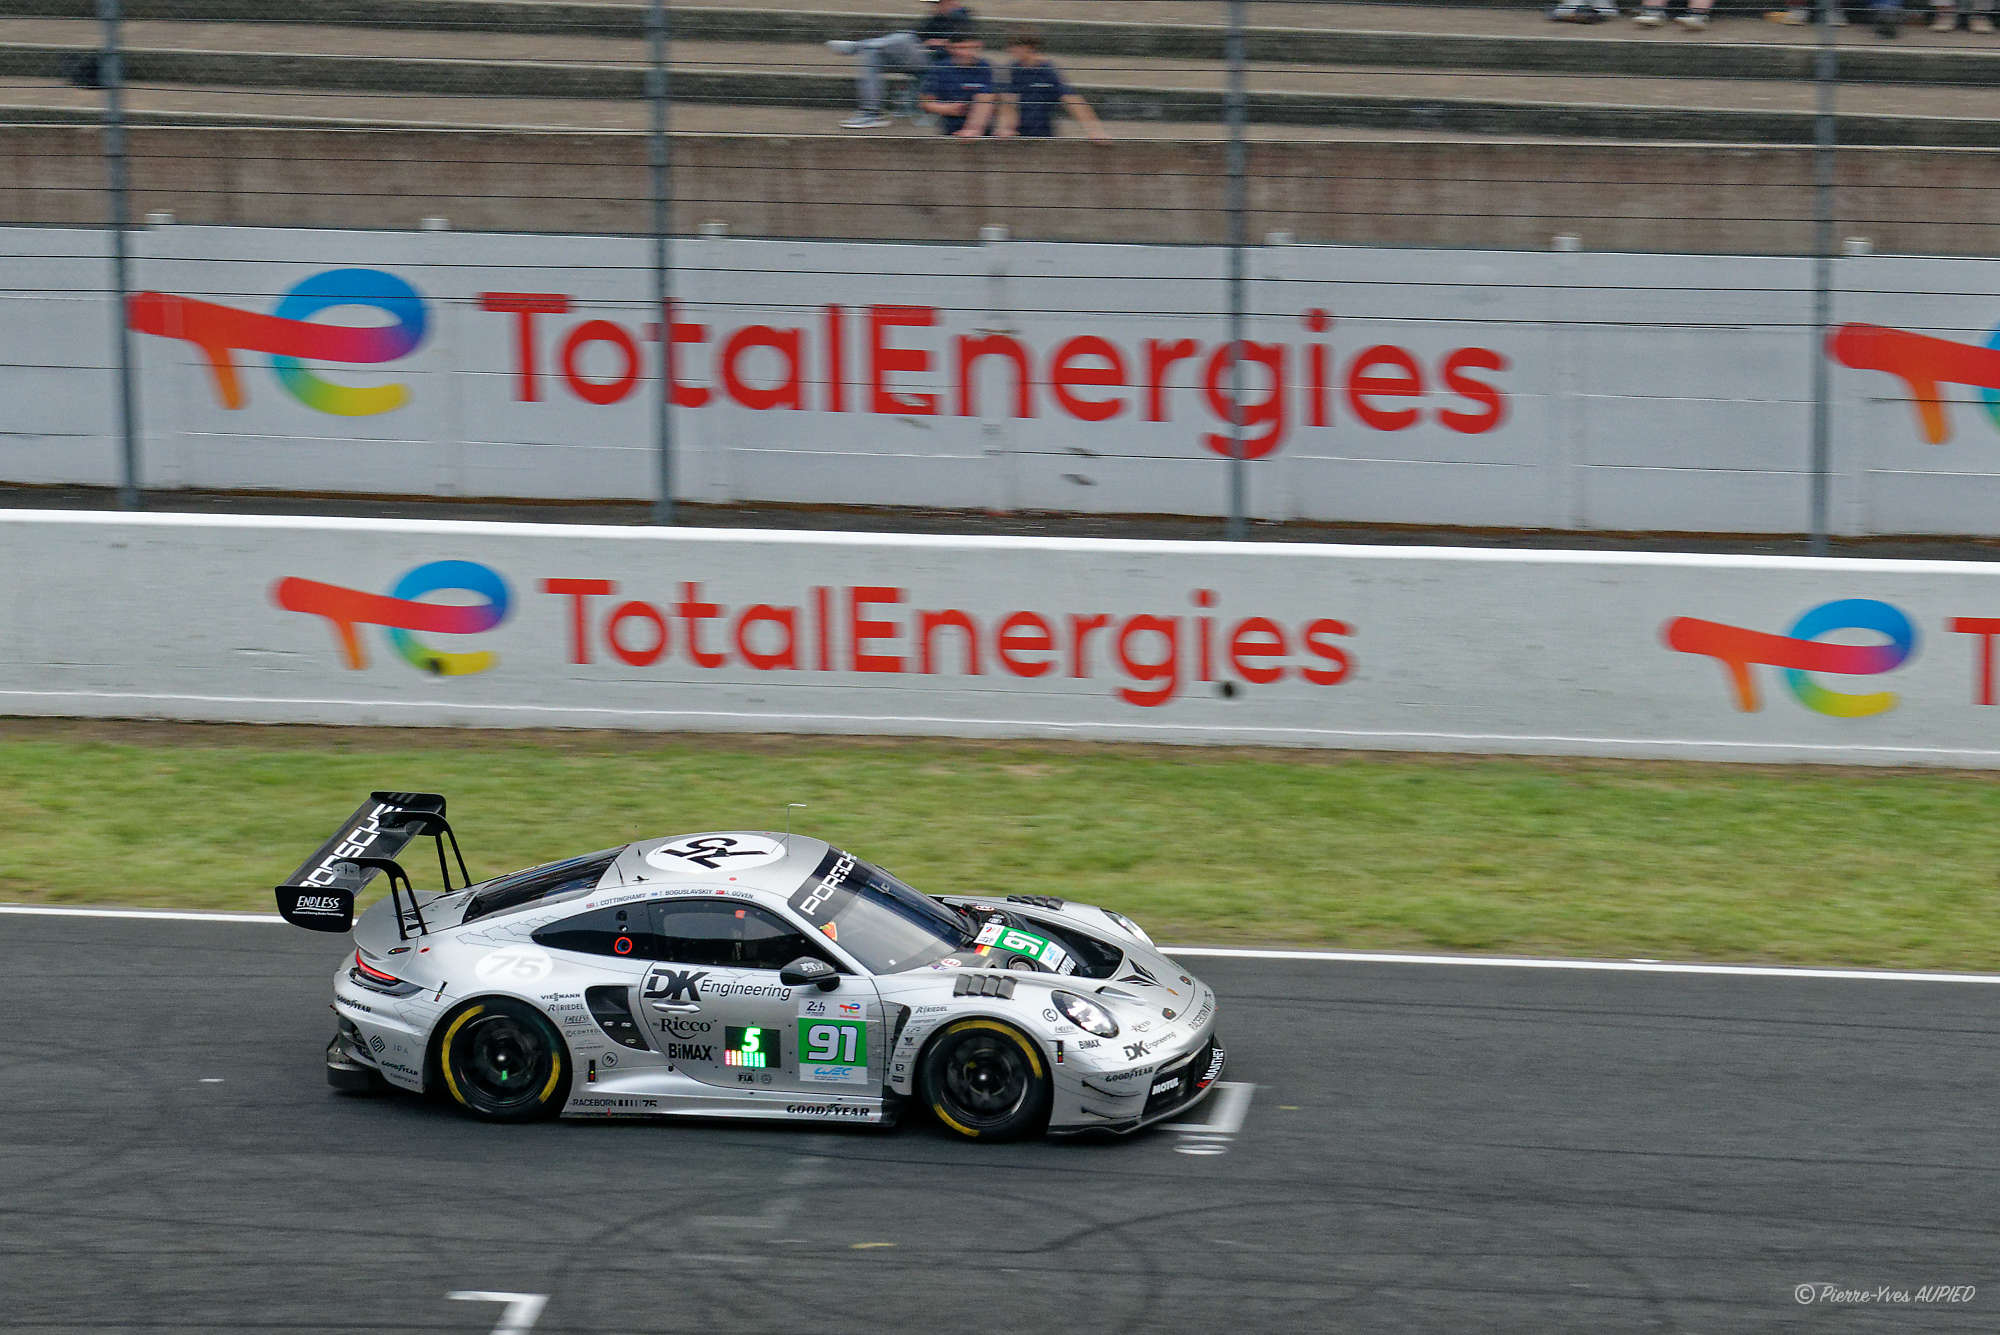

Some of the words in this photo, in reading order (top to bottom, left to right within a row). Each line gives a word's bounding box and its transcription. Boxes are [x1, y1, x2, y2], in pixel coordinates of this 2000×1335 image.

[480, 290, 1510, 460] TotalEnergies
[543, 579, 1354, 708] TotalEnergies
[296, 895, 341, 909] ENDLESS
[1002, 931, 1044, 956] 91
[485, 955, 545, 979] 75
[643, 968, 711, 1001] DK
[700, 979, 792, 1001] Engineering
[741, 1027, 761, 1053] 5
[808, 1024, 858, 1063] 91
[1123, 1041, 1151, 1061] DK
[1144, 1032, 1177, 1049] Engineering
[381, 1060, 419, 1076] GOODYEAR
[814, 1067, 853, 1076] WEC
[1105, 1067, 1153, 1082] GOODYEAR
[1202, 1048, 1224, 1080] MANTHEY
[737, 1073, 753, 1082] FIA
[571, 1099, 617, 1107] RACEBORN
[786, 1103, 870, 1117] GOODYEAR
